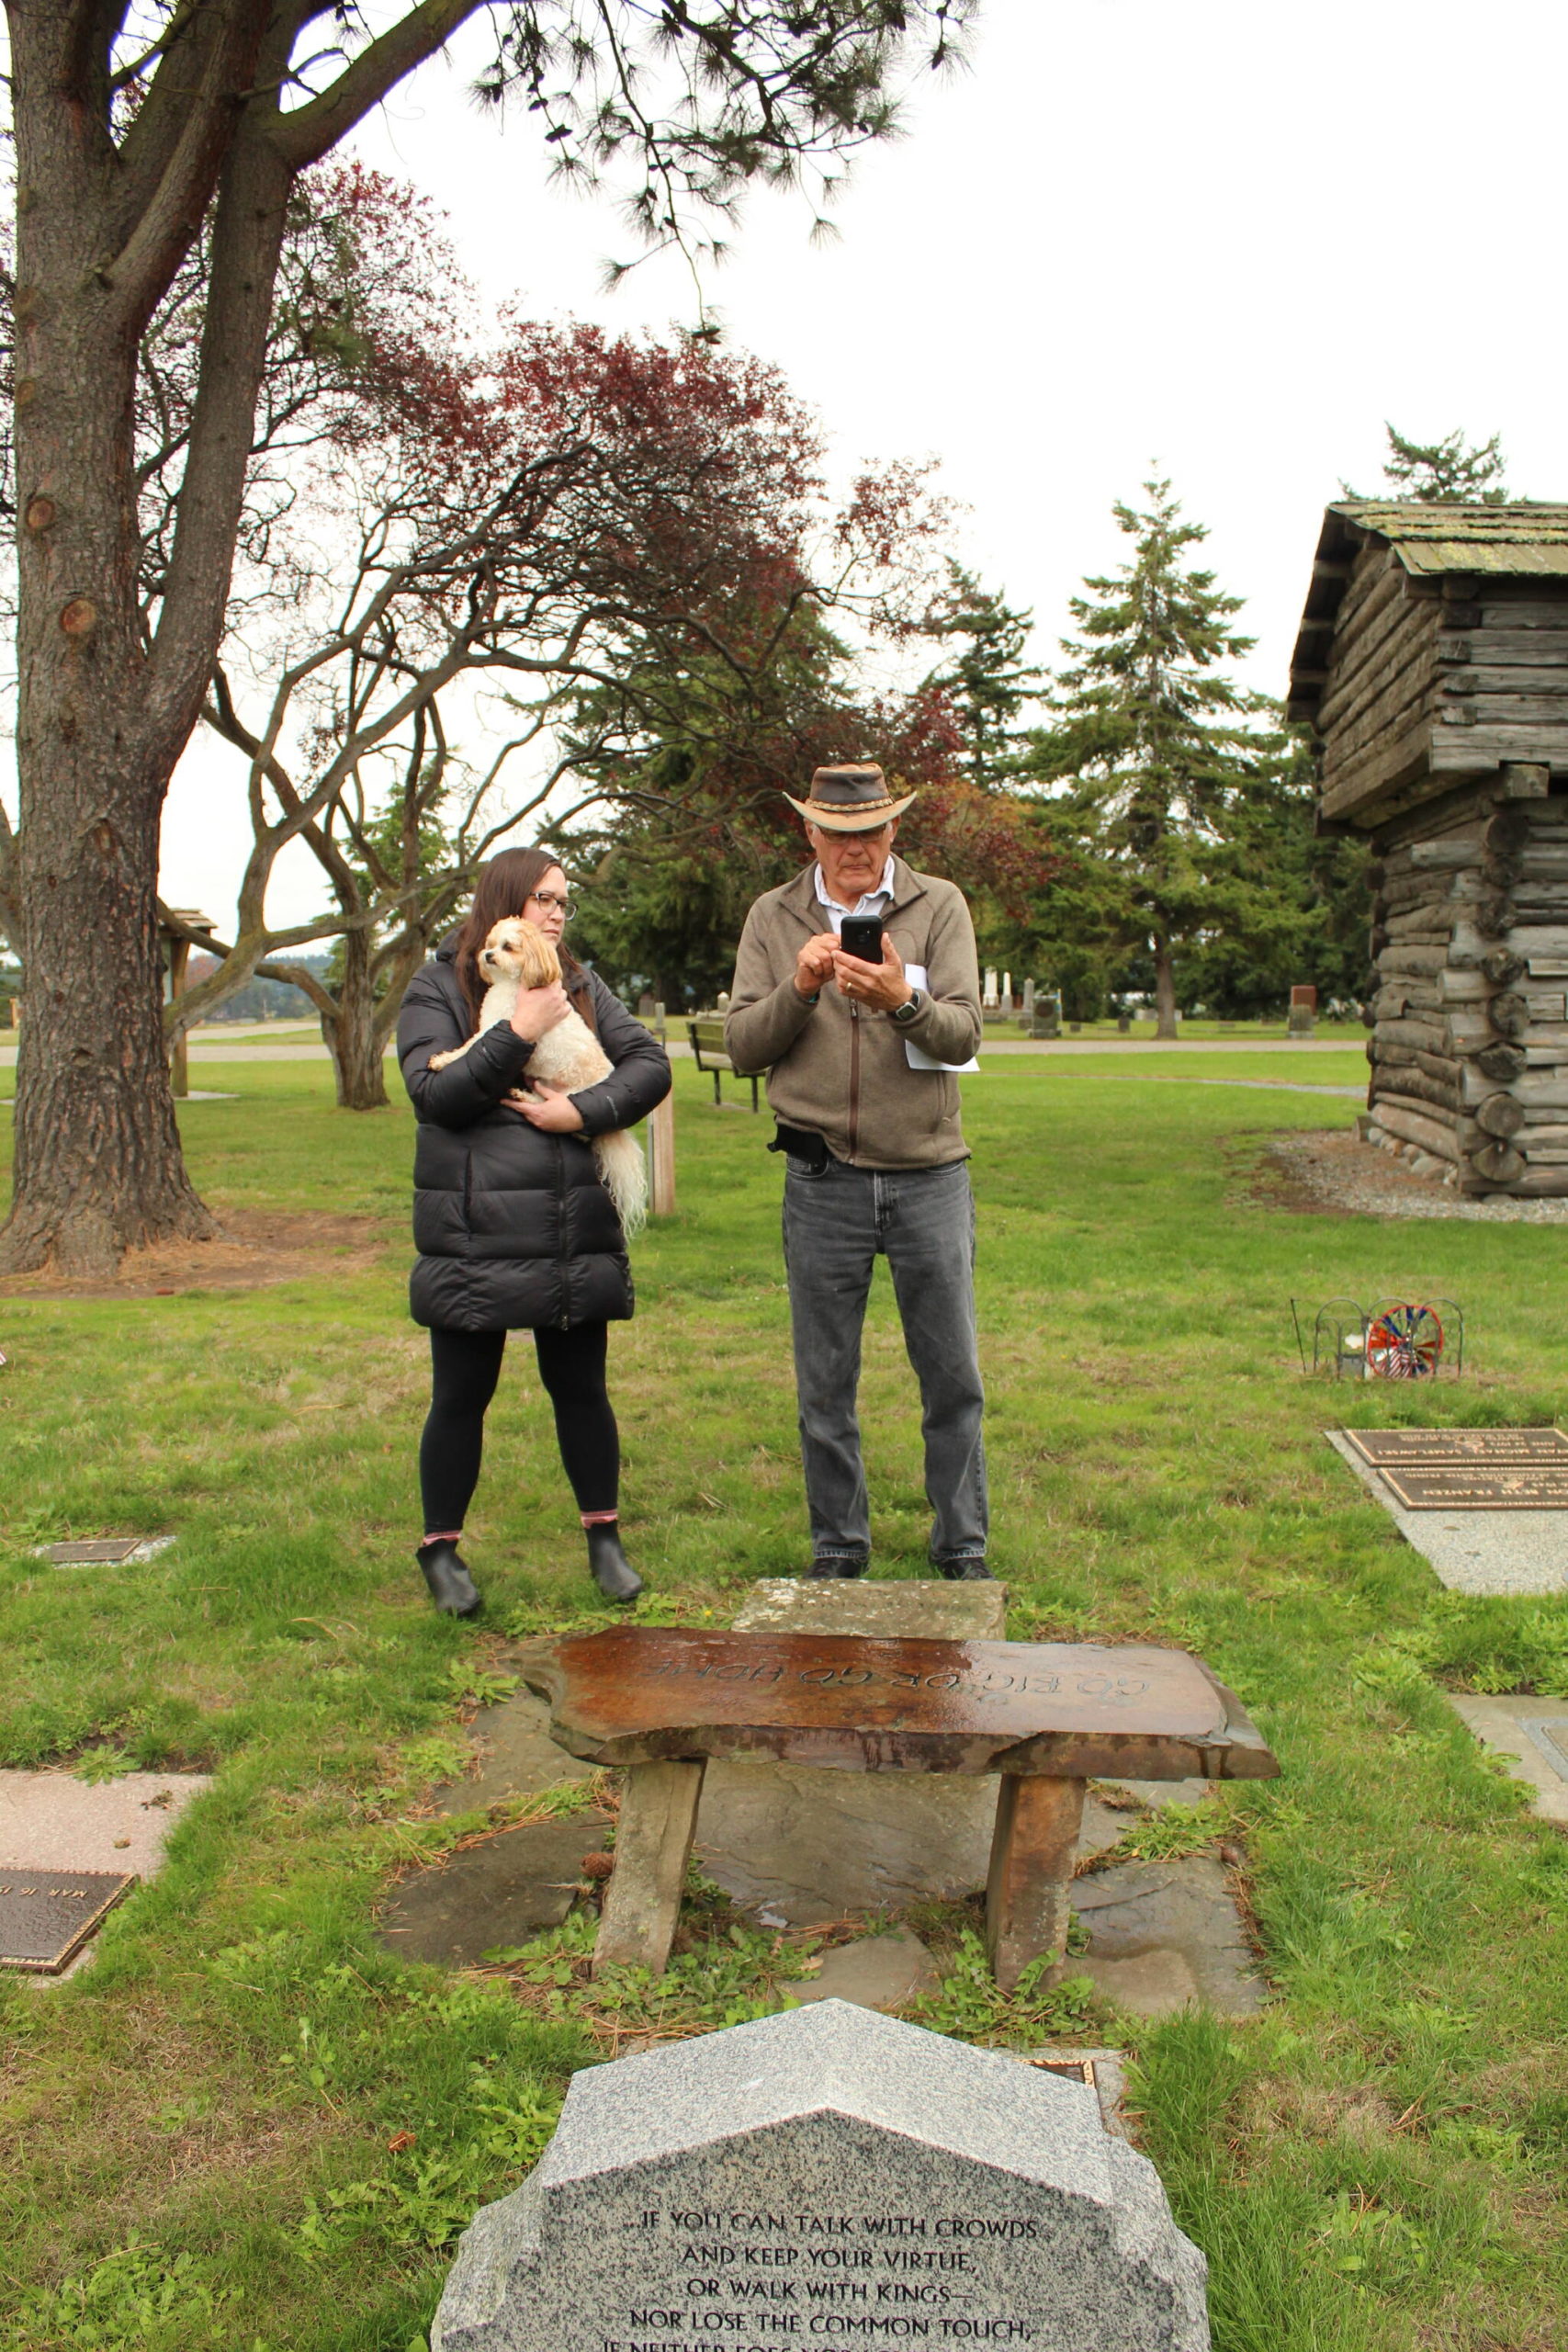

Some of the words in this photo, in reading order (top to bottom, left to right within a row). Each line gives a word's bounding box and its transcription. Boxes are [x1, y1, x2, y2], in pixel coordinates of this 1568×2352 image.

[639, 1660, 784, 1682] HOME
[799, 1666, 873, 1685] GO
[889, 1670, 960, 1689] OR
[982, 1674, 1061, 1693] BIG
[1077, 1677, 1150, 1696] GO
[19, 1886, 38, 1896] 16
[48, 1888, 88, 1898] MAR
[670, 2211, 721, 2231] YOU
[731, 2213, 785, 2232] CAN
[795, 2215, 854, 2234] TALK
[864, 2217, 925, 2235] WITH
[935, 2219, 1037, 2238] CROWDS
[681, 2246, 736, 2265] AND
[745, 2247, 799, 2267] KEEP
[808, 2249, 873, 2268] YOUR
[884, 2252, 977, 2274] VIRTUE,
[687, 2278, 720, 2297] OR
[729, 2279, 797, 2300] WALK
[807, 2282, 867, 2301] WITH
[630, 2309, 682, 2328] NOR
[692, 2312, 748, 2331] LOSE
[756, 2313, 801, 2332] THE
[809, 2315, 929, 2336] COMMON
[939, 2319, 1031, 2342] TOUCH,
